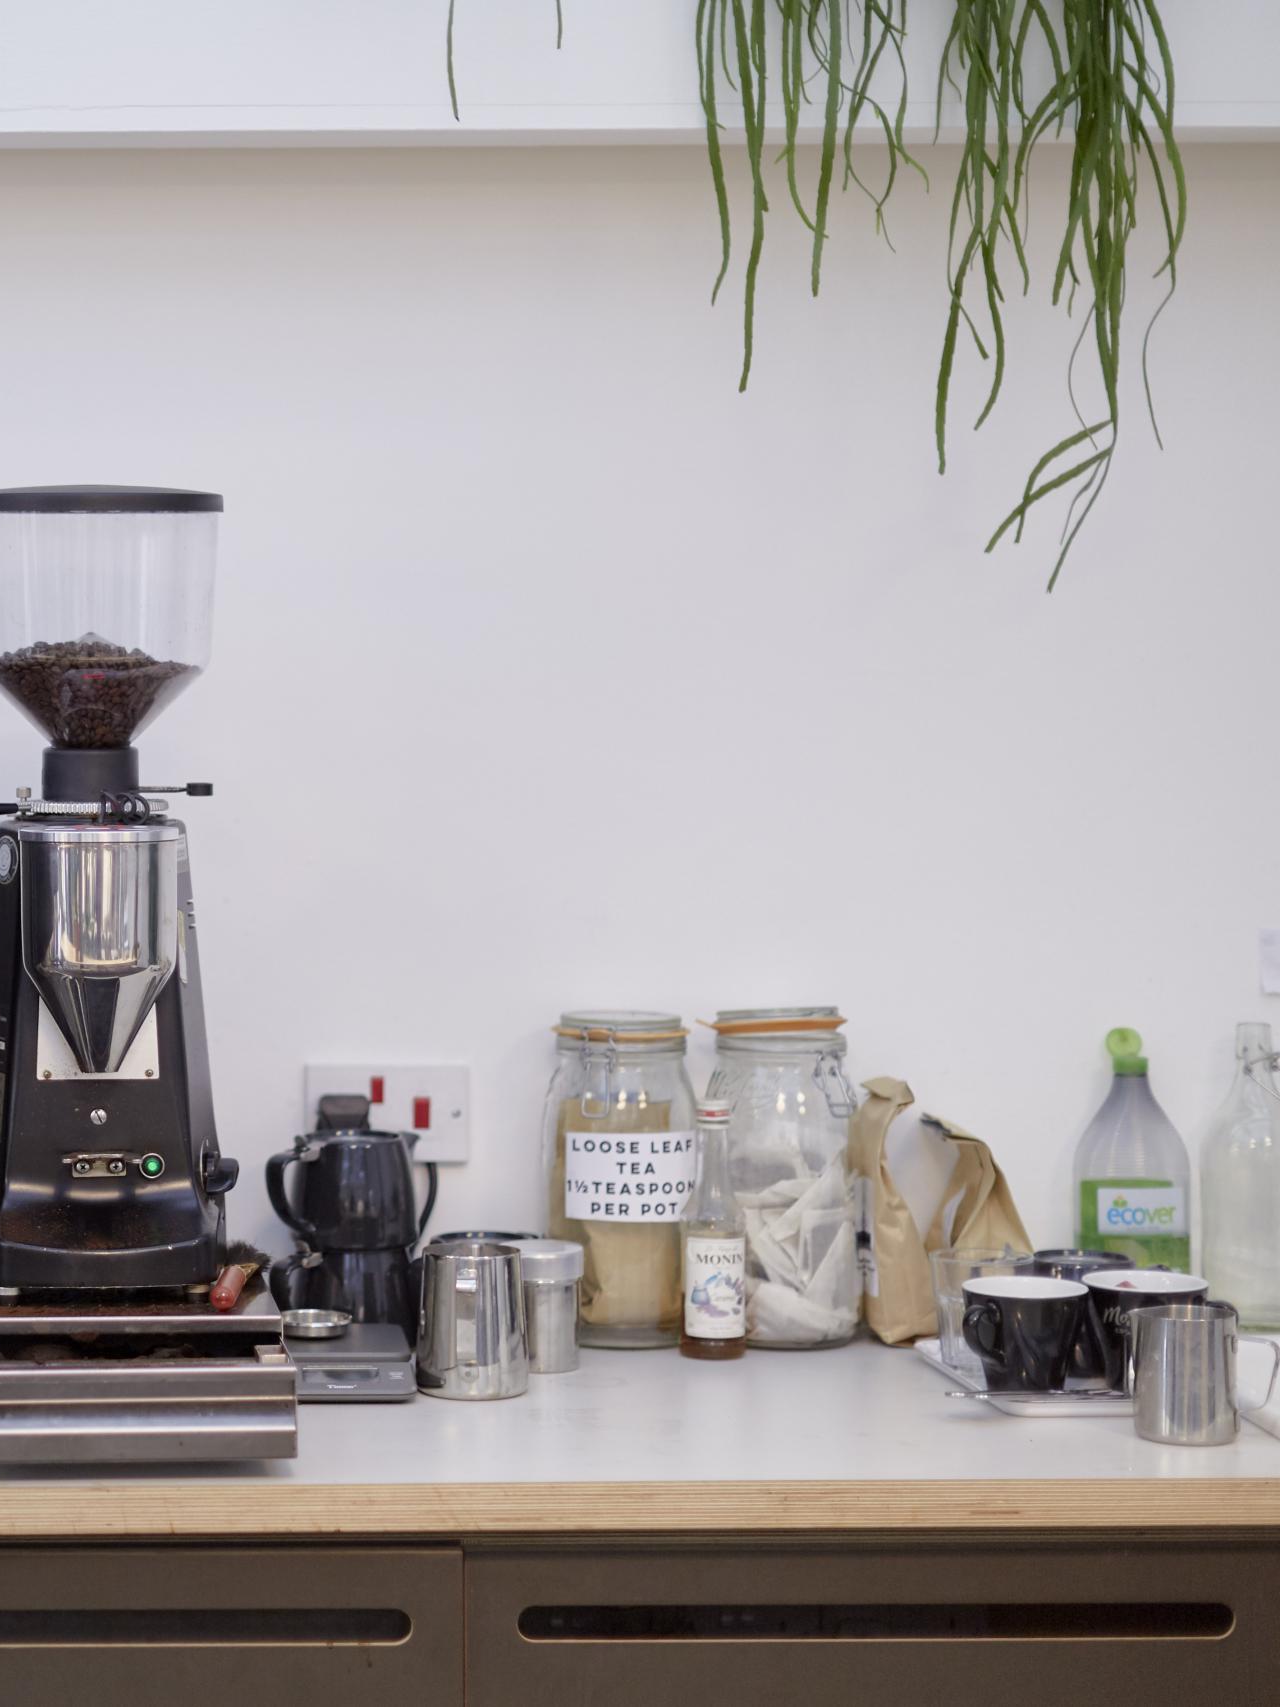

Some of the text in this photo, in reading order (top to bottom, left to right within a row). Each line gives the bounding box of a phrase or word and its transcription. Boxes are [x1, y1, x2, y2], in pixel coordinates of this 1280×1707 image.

[571, 1138, 693, 1154] LOOSE LEAF
[616, 1161, 656, 1175] TEA
[590, 1202, 678, 1216] PER POT
[1107, 1206, 1176, 1226] ecover
